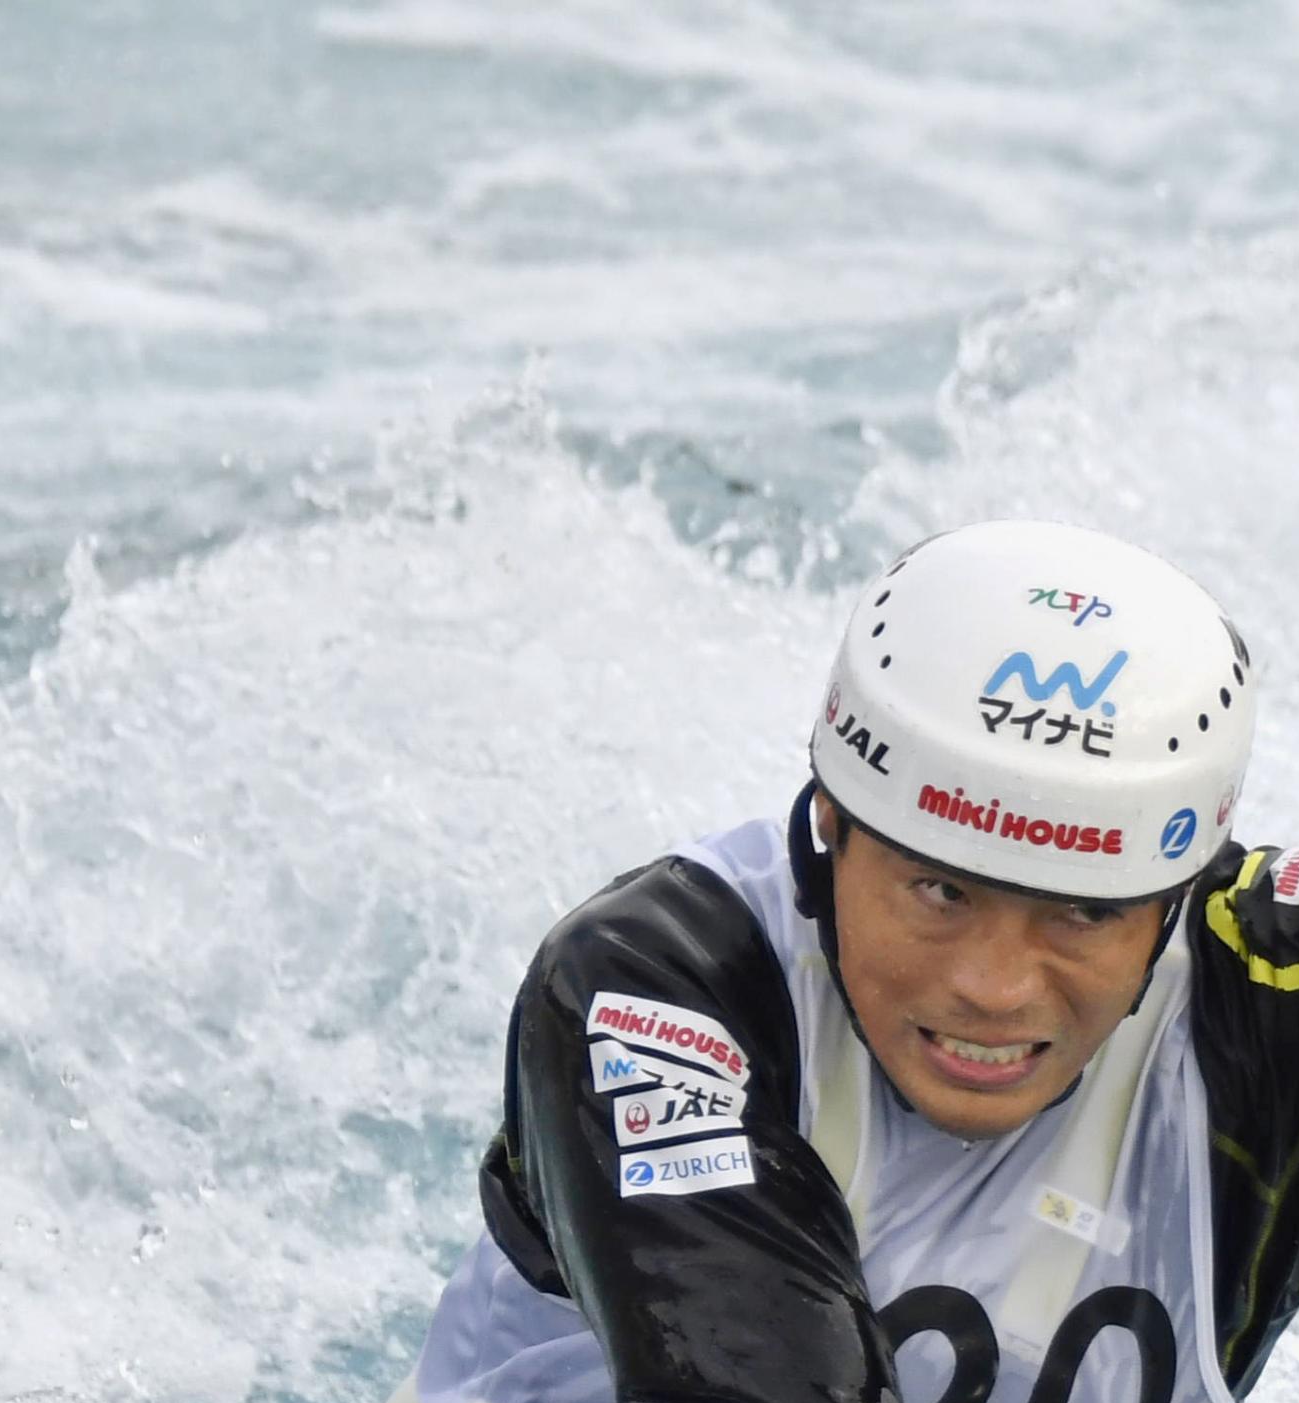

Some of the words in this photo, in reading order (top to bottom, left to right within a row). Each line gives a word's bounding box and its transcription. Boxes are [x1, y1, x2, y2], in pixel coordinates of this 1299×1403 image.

[835, 713, 890, 776] JAL
[978, 696, 1115, 758] マイナビ
[999, 811, 1123, 855] HOUSE
[655, 1020, 743, 1076] HOUSE
[659, 1151, 748, 1181] ZURICH
